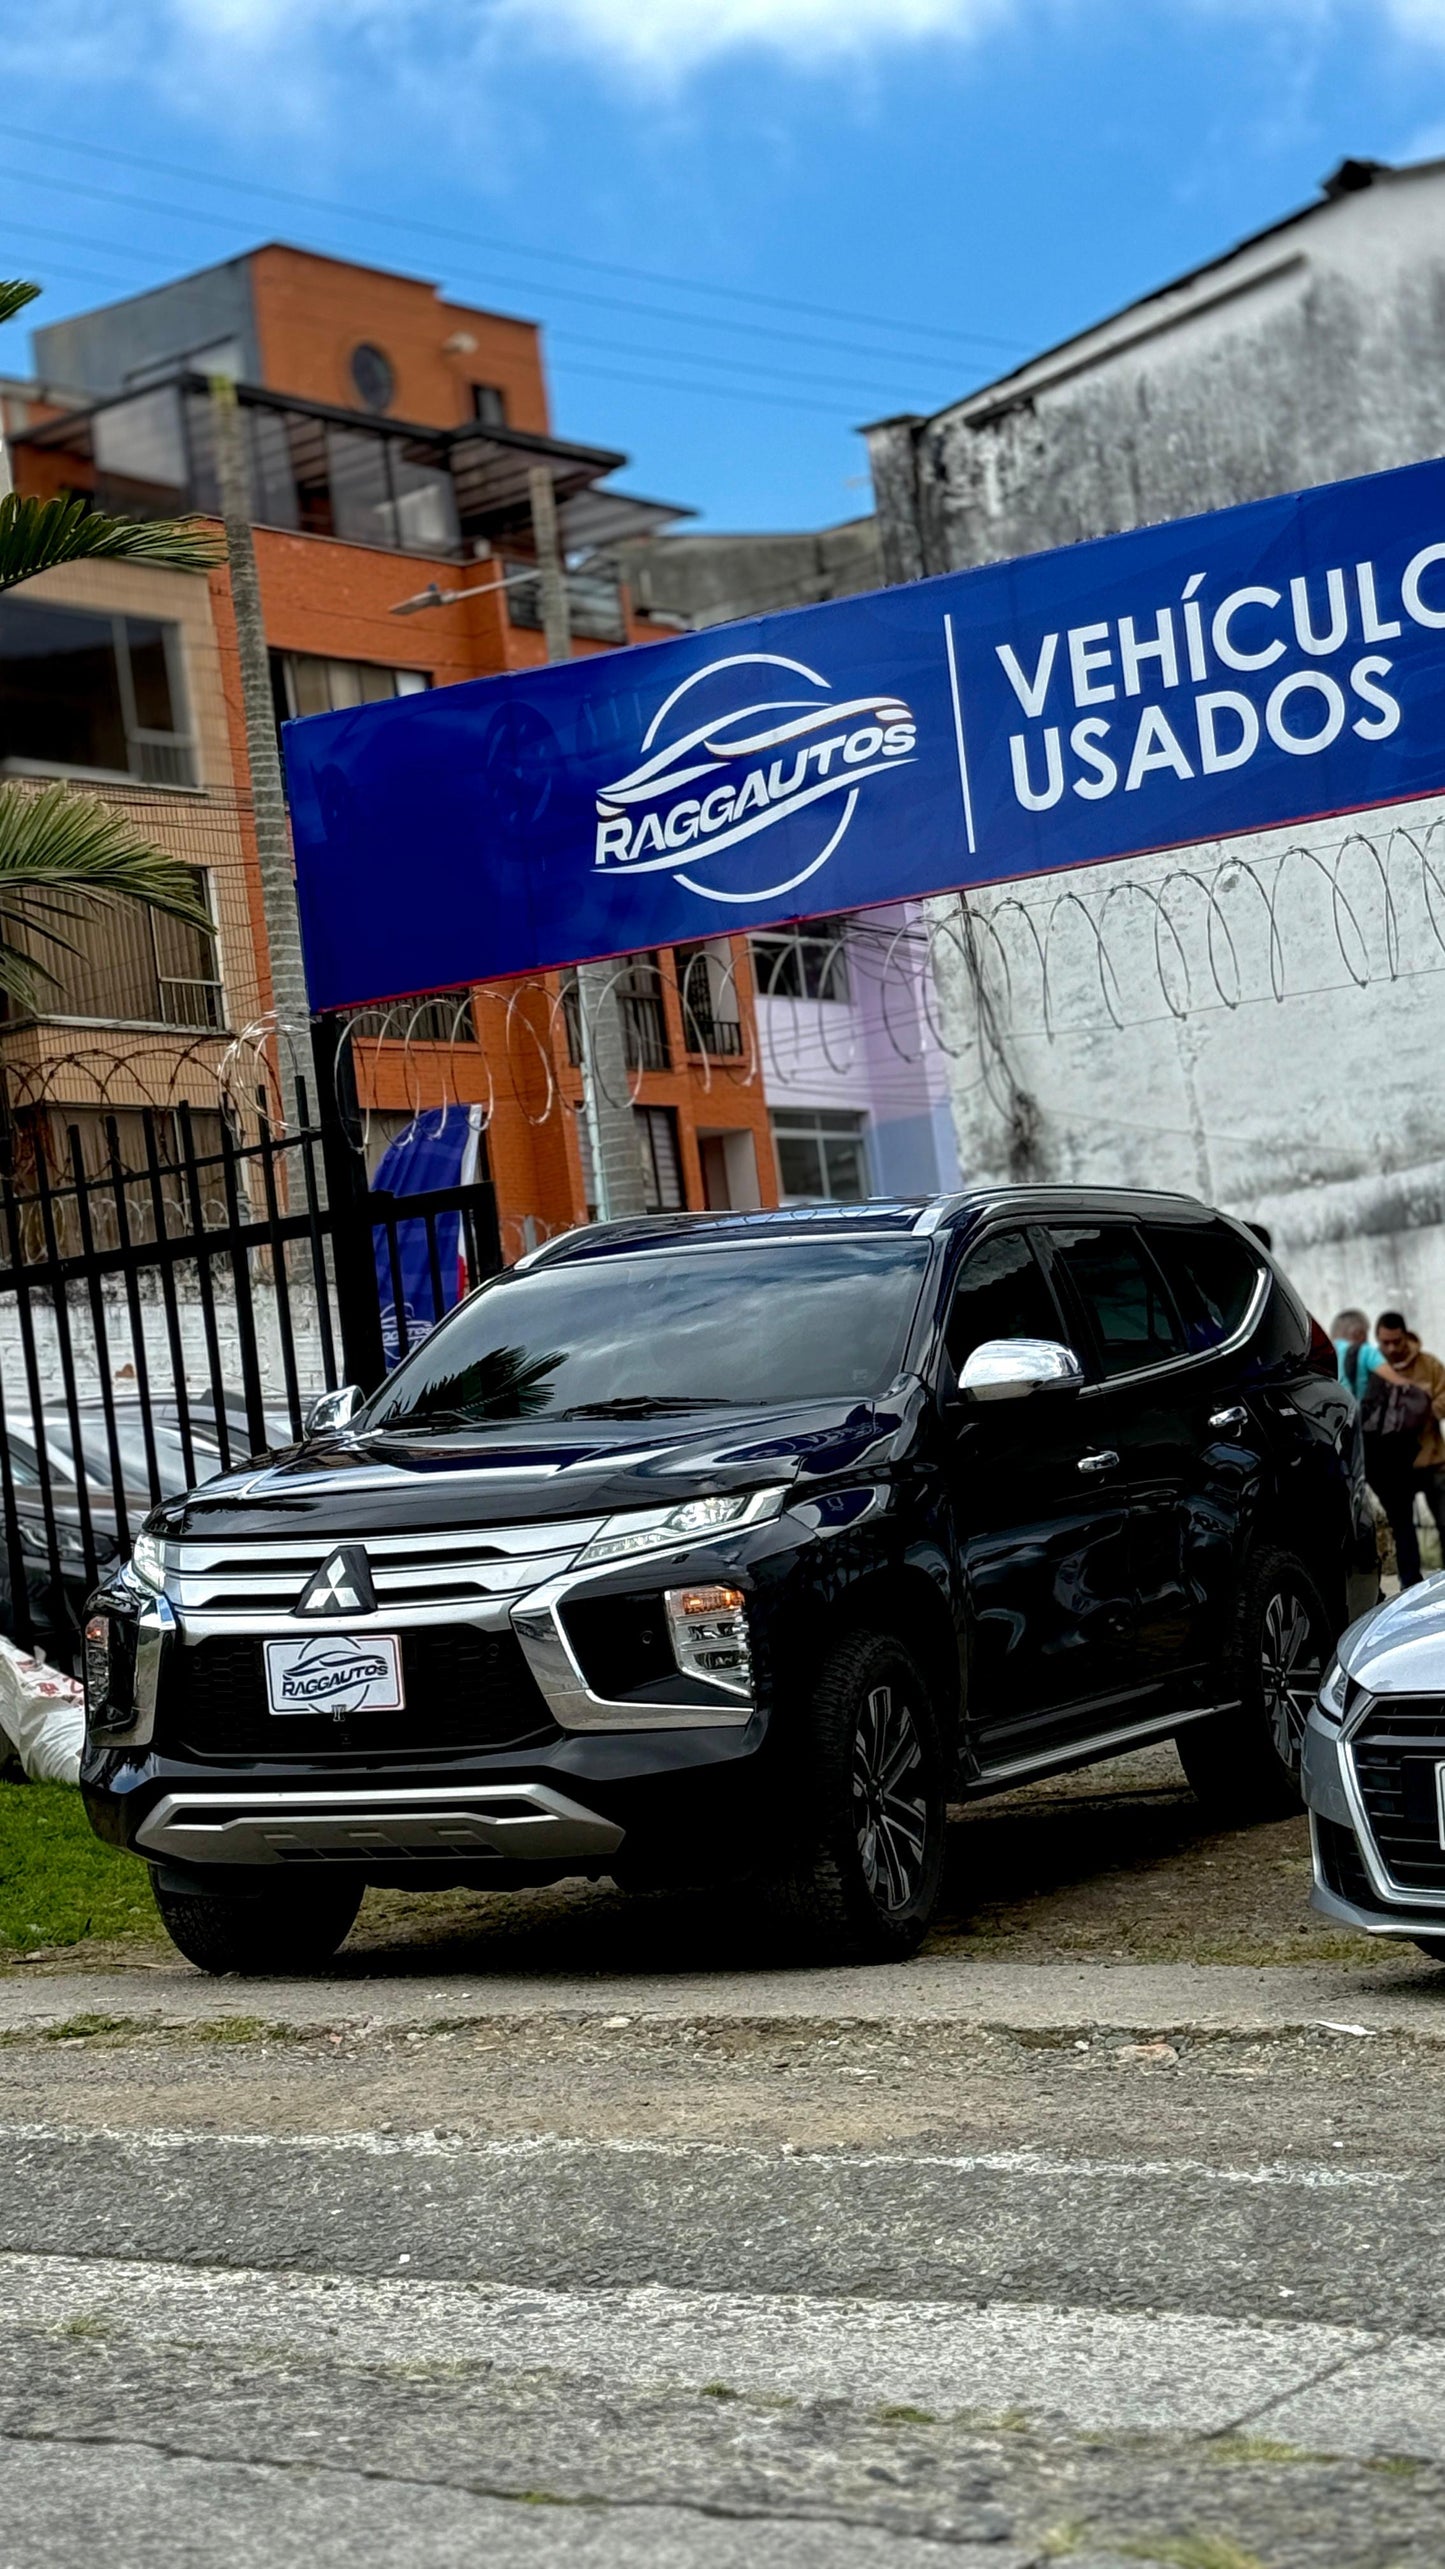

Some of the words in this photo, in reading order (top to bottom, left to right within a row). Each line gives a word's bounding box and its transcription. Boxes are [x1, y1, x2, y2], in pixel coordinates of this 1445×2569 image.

[595, 723, 917, 865] RAGGAUTOS
[1009, 655, 1401, 812] USADOS
[282, 1664, 389, 1697] RAGGAUTOS
